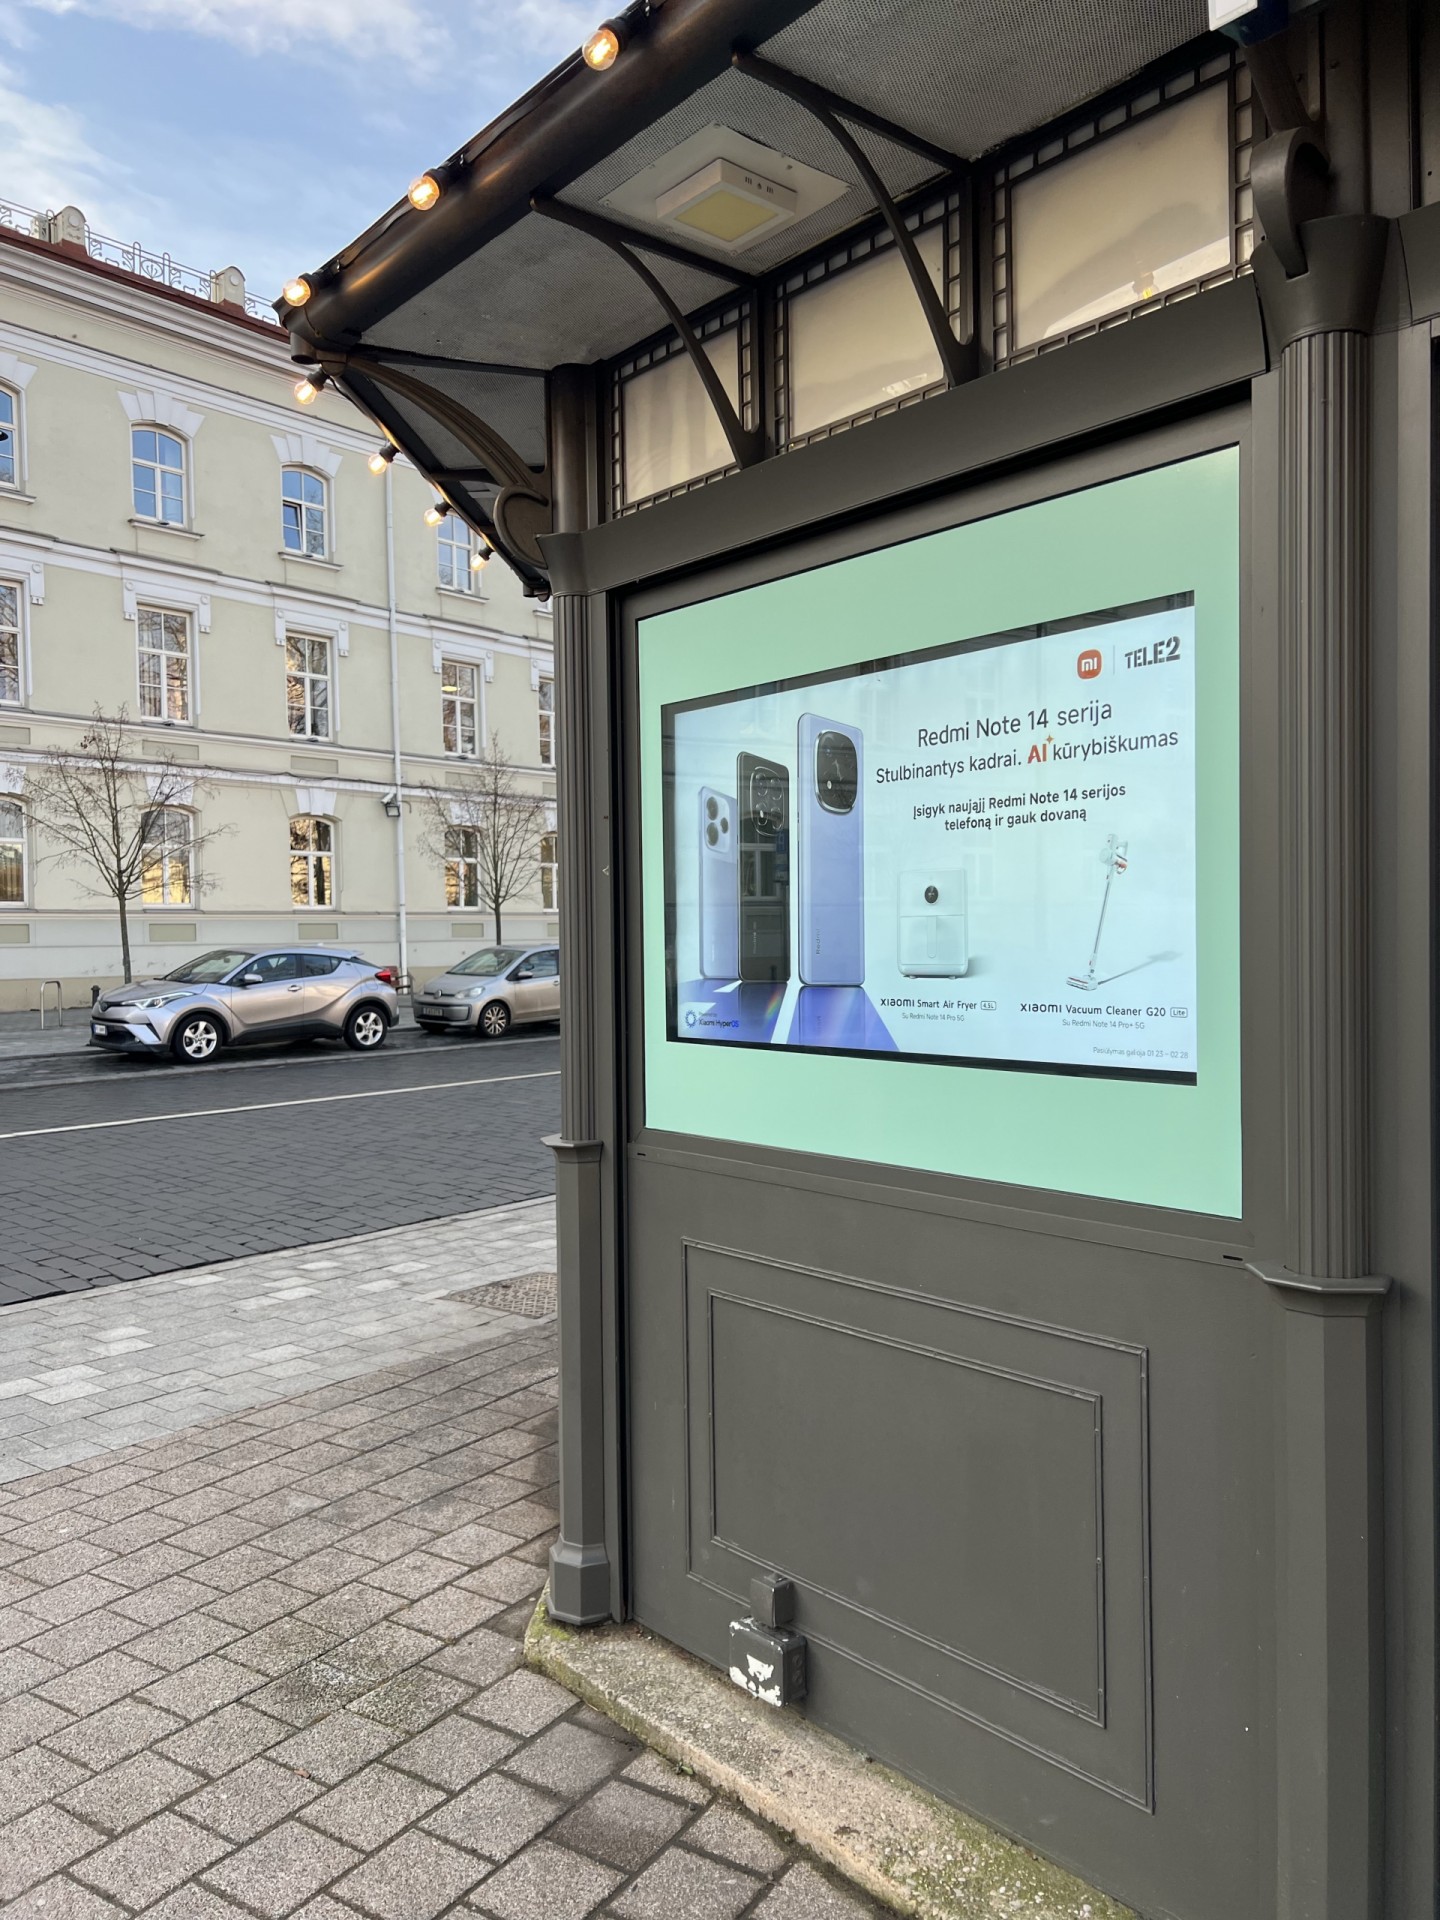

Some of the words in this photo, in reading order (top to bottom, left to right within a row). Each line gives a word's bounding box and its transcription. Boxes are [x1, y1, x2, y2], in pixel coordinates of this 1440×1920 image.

[1124, 636, 1181, 669] TELE2
[918, 721, 970, 748] Redmi
[976, 715, 1021, 739] Note
[1027, 709, 1049, 730] 14
[1057, 700, 1112, 727] serija
[876, 759, 965, 784] Stulbinantys
[969, 750, 1022, 772] kadrai.
[1027, 743, 1048, 764] AI
[1053, 729, 1179, 761] kūrybiškumas
[913, 802, 945, 820] Įsigyk
[948, 799, 986, 815] naująjį
[989, 793, 1026, 810] Redmi
[1029, 791, 1060, 806] Note
[1063, 788, 1078, 802] 14
[1081, 783, 1126, 801] serijos
[944, 814, 992, 831] telefoną
[995, 814, 1004, 827] ir
[1007, 812, 1036, 828] gauk
[1040, 806, 1087, 823] dovaną
[909, 1012, 925, 1020] Redmi
[940, 1013, 946, 1021] 14
[917, 999, 940, 1009] Smart
[943, 1000, 954, 1009] Air
[957, 1000, 977, 1012] Fryer
[1065, 1004, 1102, 1015] Vacuum
[1105, 1005, 1142, 1016] Cleaner
[1146, 1007, 1166, 1017] G20
[1172, 1009, 1186, 1017] Lite
[1062, 1018, 1070, 1026] Su
[1071, 1019, 1091, 1027] Redmi
[1092, 1019, 1108, 1028] Note
[1109, 1020, 1117, 1028] 14
[1135, 1021, 1145, 1030] 5G
